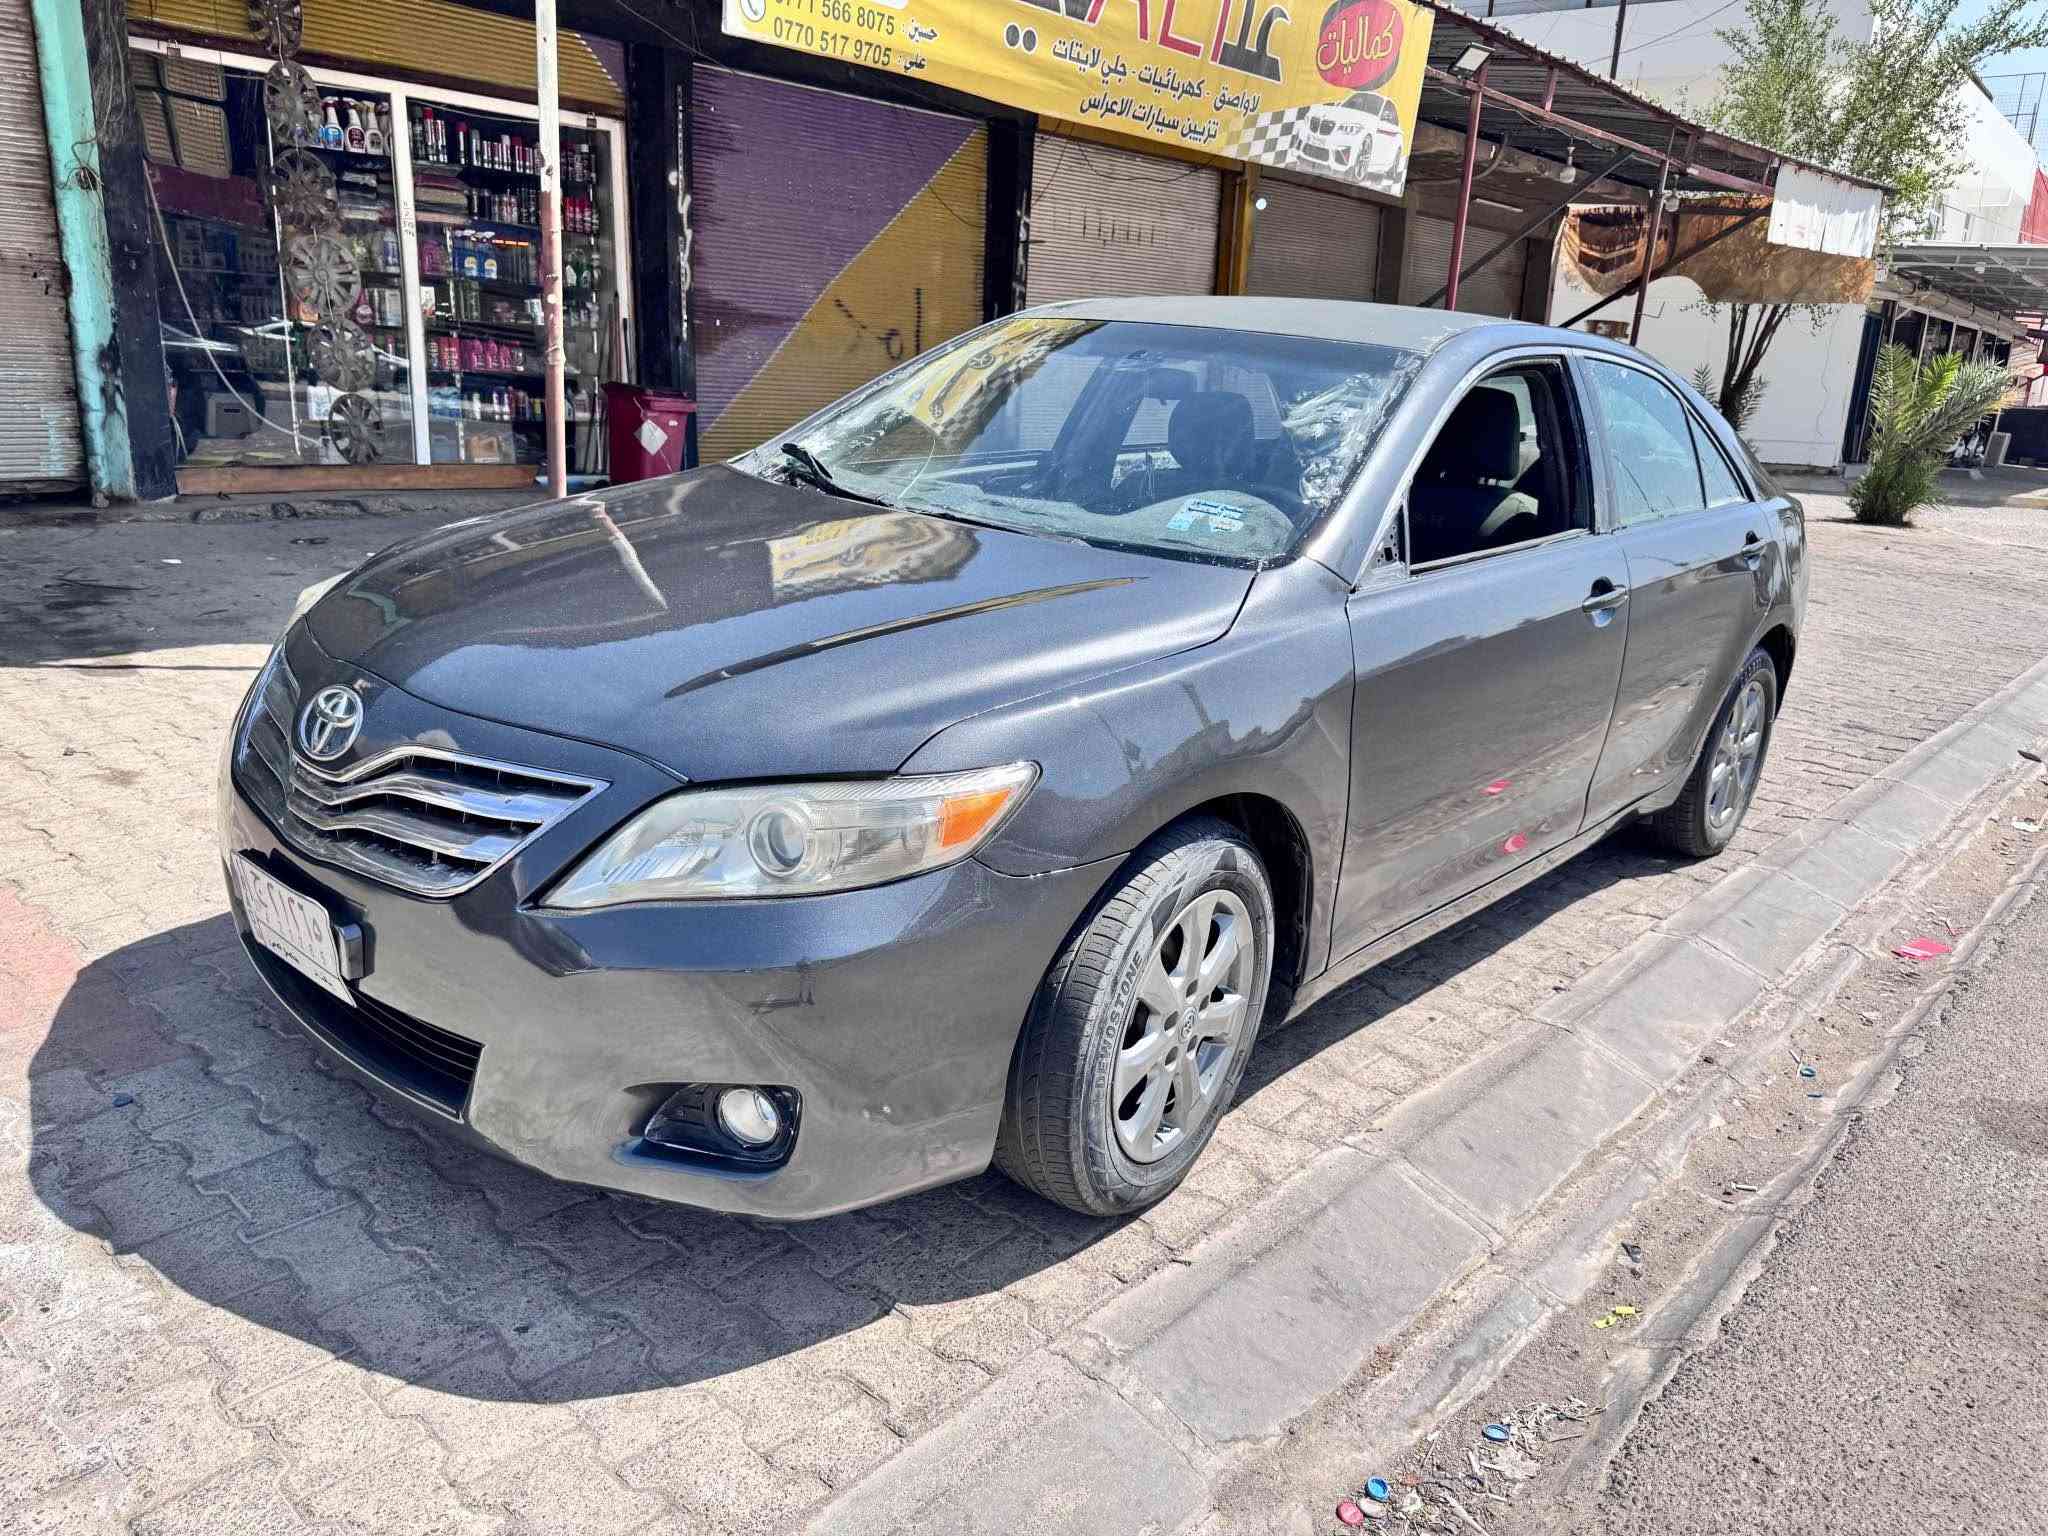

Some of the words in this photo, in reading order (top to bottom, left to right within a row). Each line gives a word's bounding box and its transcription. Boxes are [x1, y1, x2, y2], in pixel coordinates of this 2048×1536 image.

[822, 0, 851, 23] 566
[857, 6, 895, 36] 8075
[908, 18, 938, 42] حسين
[774, 16, 814, 47] 0770
[820, 31, 850, 57] 517
[854, 39, 892, 66] 9705
[1052, 39, 1101, 73] لايتات
[1316, 9, 1397, 74] كماليات
[904, 53, 926, 73] علي
[1101, 54, 1127, 84] جلي
[1138, 66, 1205, 101] كهربائيات
[1080, 91, 1133, 118] الاعراس
[1132, 103, 1179, 133] سيارات
[1181, 117, 1218, 144] تزيين
